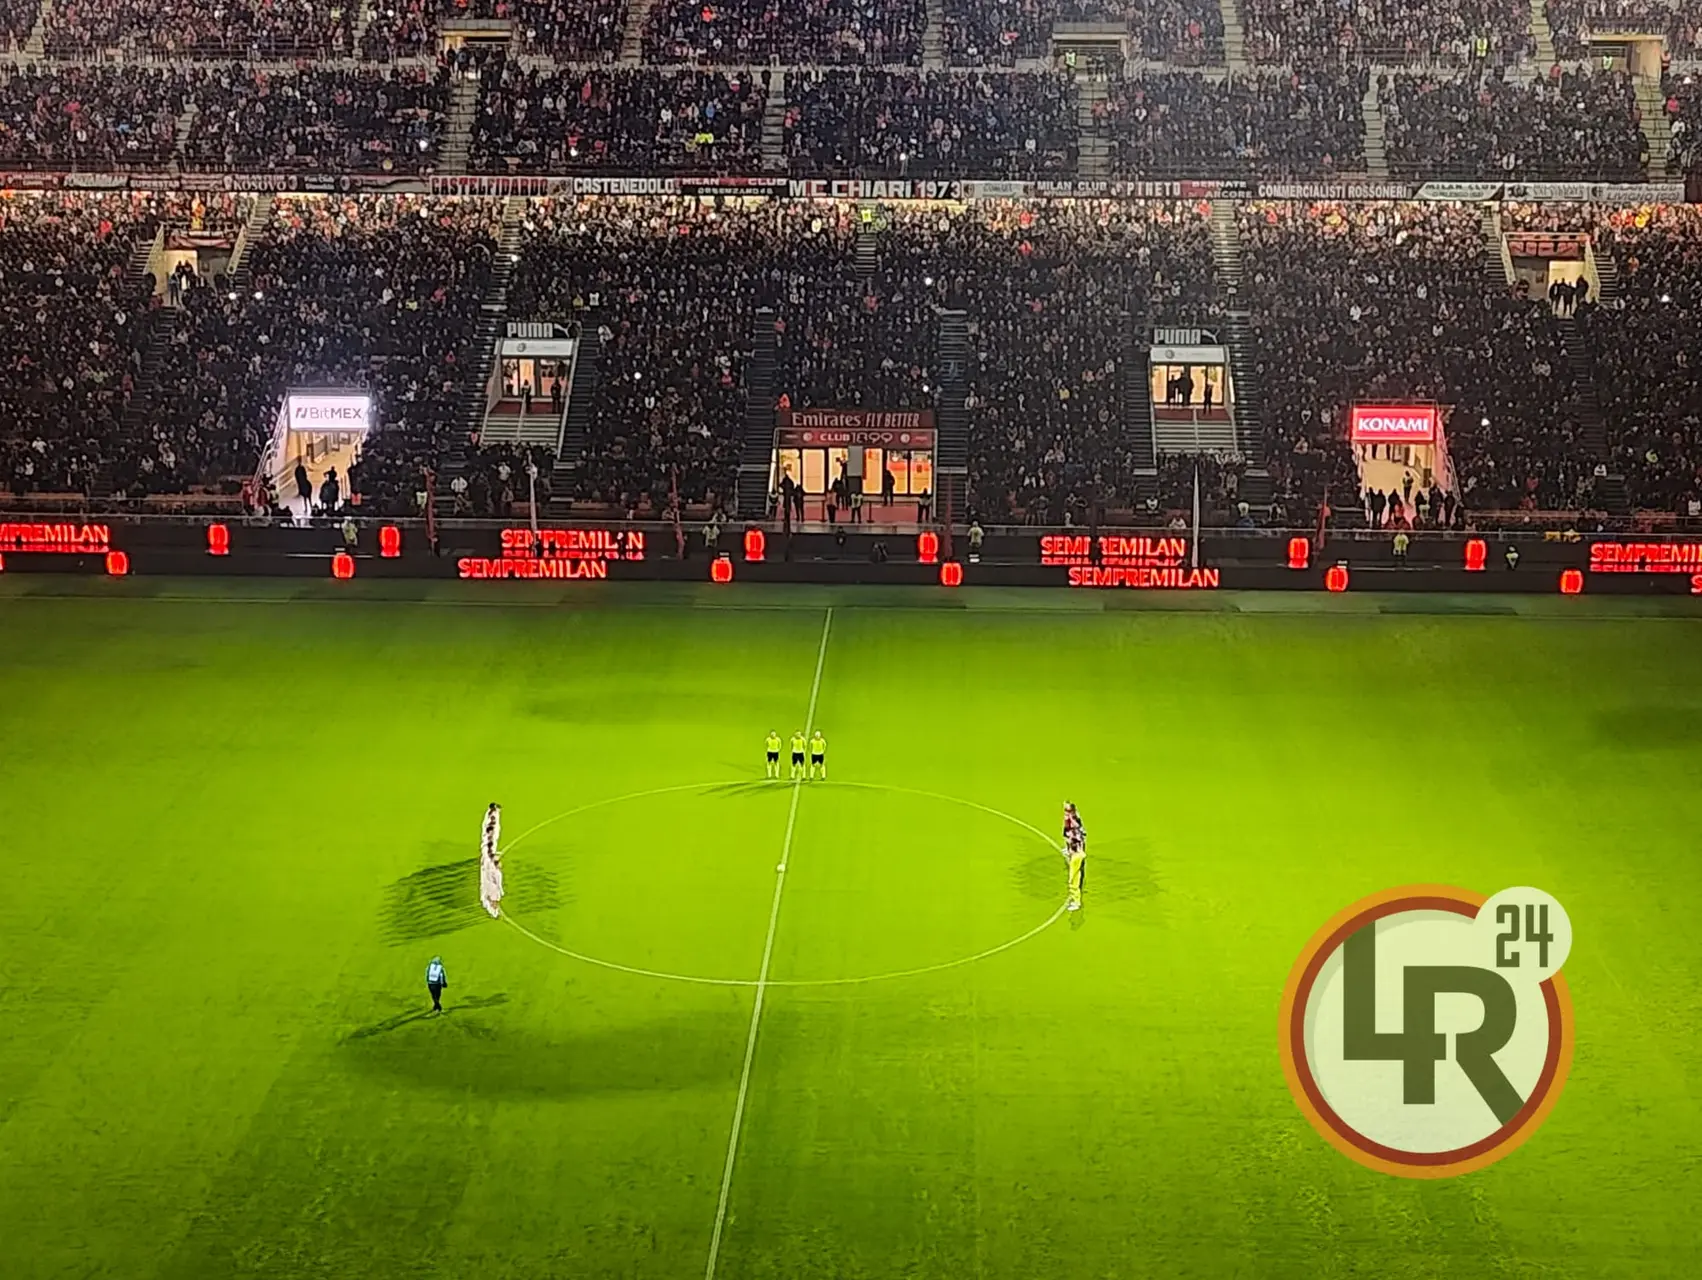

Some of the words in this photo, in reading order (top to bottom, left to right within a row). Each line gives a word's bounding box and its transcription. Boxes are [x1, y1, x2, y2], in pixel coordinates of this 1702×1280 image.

[233, 180, 286, 190] KOSOVO
[431, 177, 548, 195] CASTELFIDARDO
[748, 178, 787, 186] CLUB
[1037, 181, 1073, 191] MILAN
[1078, 181, 1107, 191] CLUB
[1127, 182, 1180, 197] PINETO
[1205, 190, 1252, 198] ARCORE
[1258, 184, 1345, 198] COMMERCIALISTI
[1349, 184, 1407, 199] ROSSONERI
[507, 322, 553, 338] PUMA
[1154, 328, 1201, 344] PUMA
[310, 407, 362, 419] BitMEX
[792, 412, 861, 427] Emirates
[865, 413, 882, 427] FLY
[884, 413, 920, 427] BETTER
[1359, 417, 1428, 432] KONAMI
[820, 434, 850, 442] CLUB
[1590, 544, 1702, 562] SEMPREMI
[458, 558, 606, 578] SEMPREMILAN
[1068, 566, 1219, 587] SEMPREMILAN
